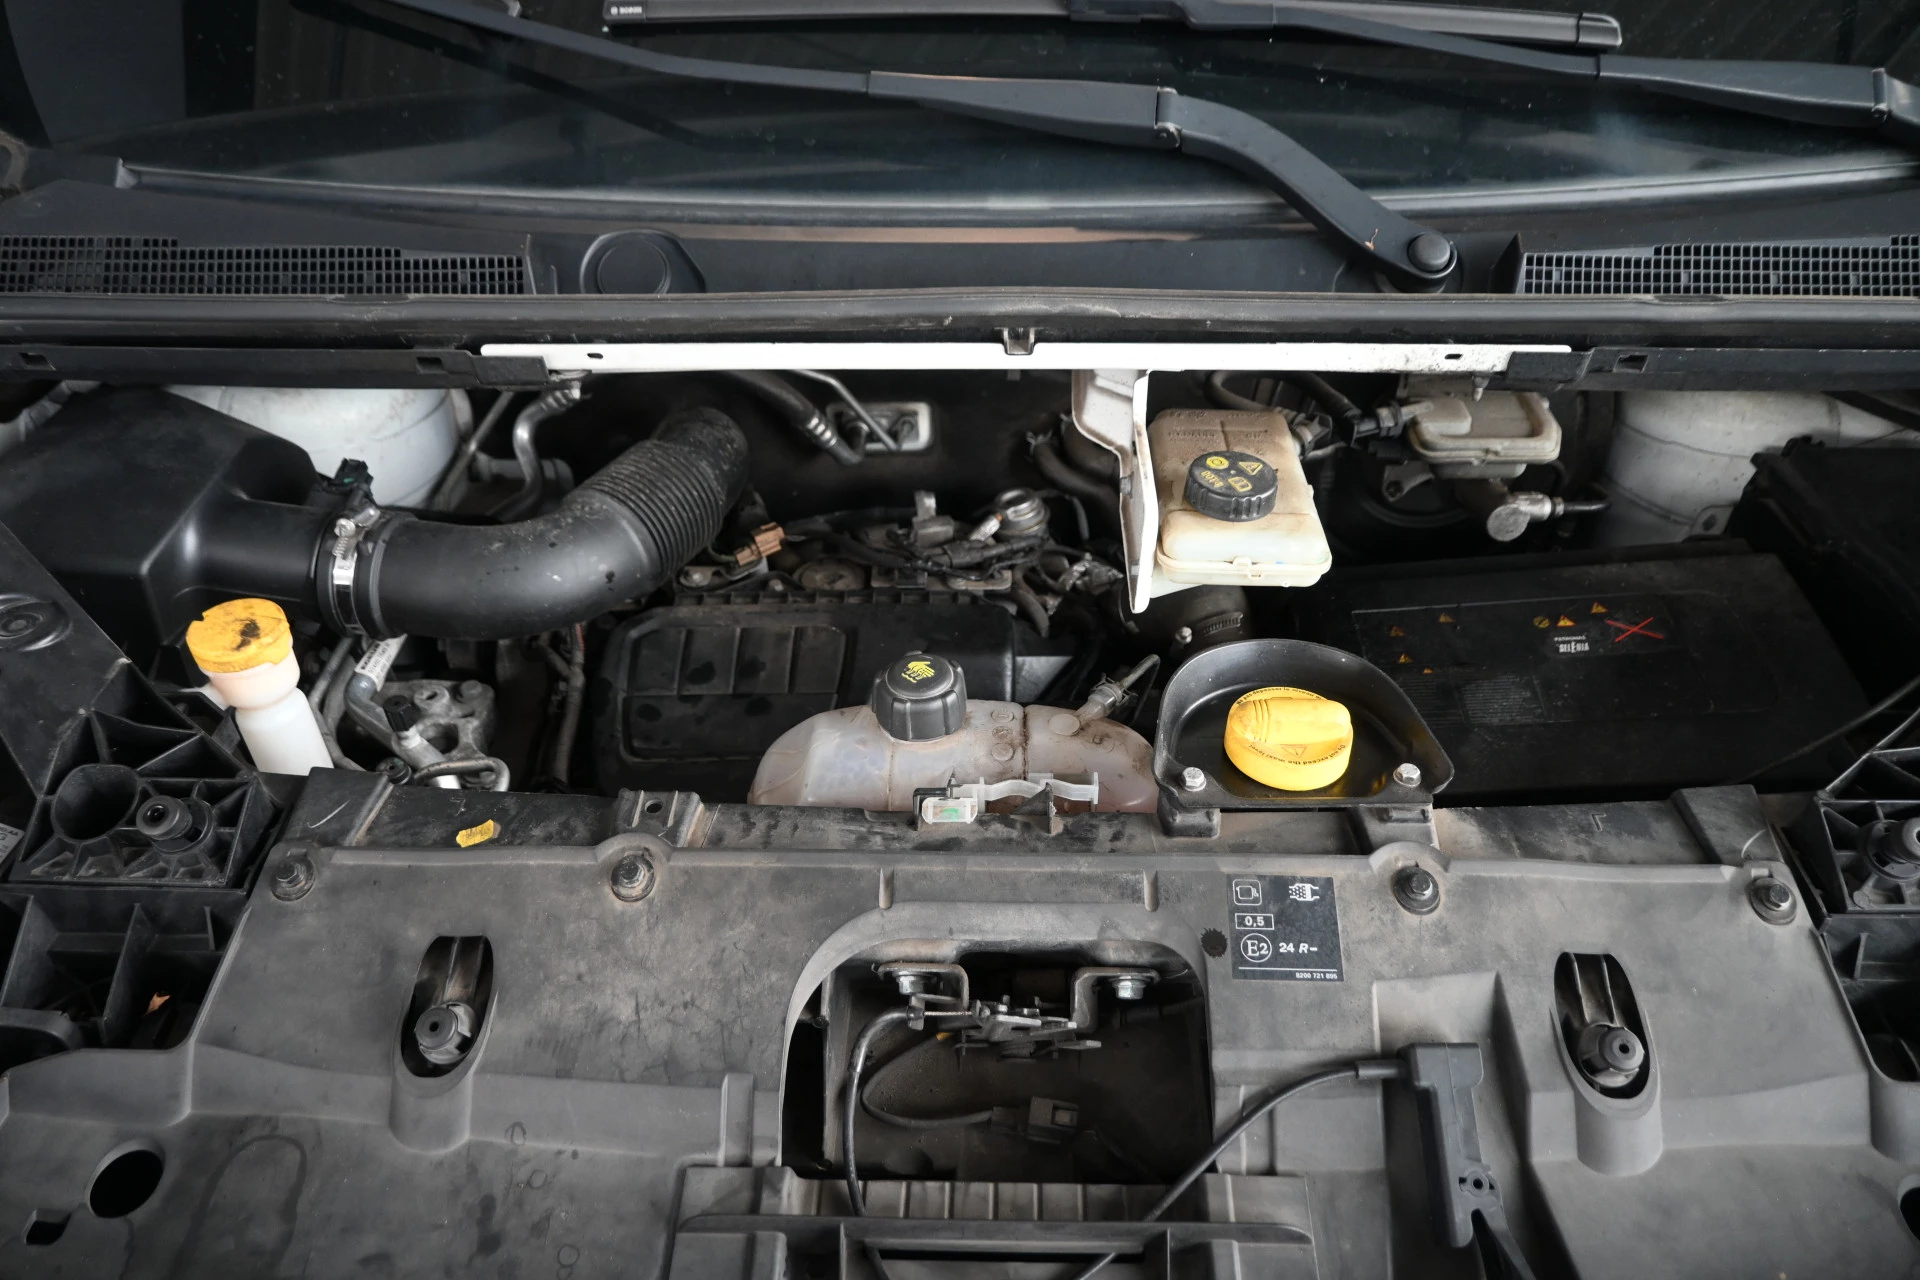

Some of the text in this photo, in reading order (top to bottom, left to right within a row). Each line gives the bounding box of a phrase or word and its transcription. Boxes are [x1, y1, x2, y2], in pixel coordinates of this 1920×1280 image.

[1302, 755, 1328, 765] exceed
[1244, 916, 1265, 927] 0,5
[1246, 940, 1269, 957] E2
[1279, 943, 1295, 953] 24
